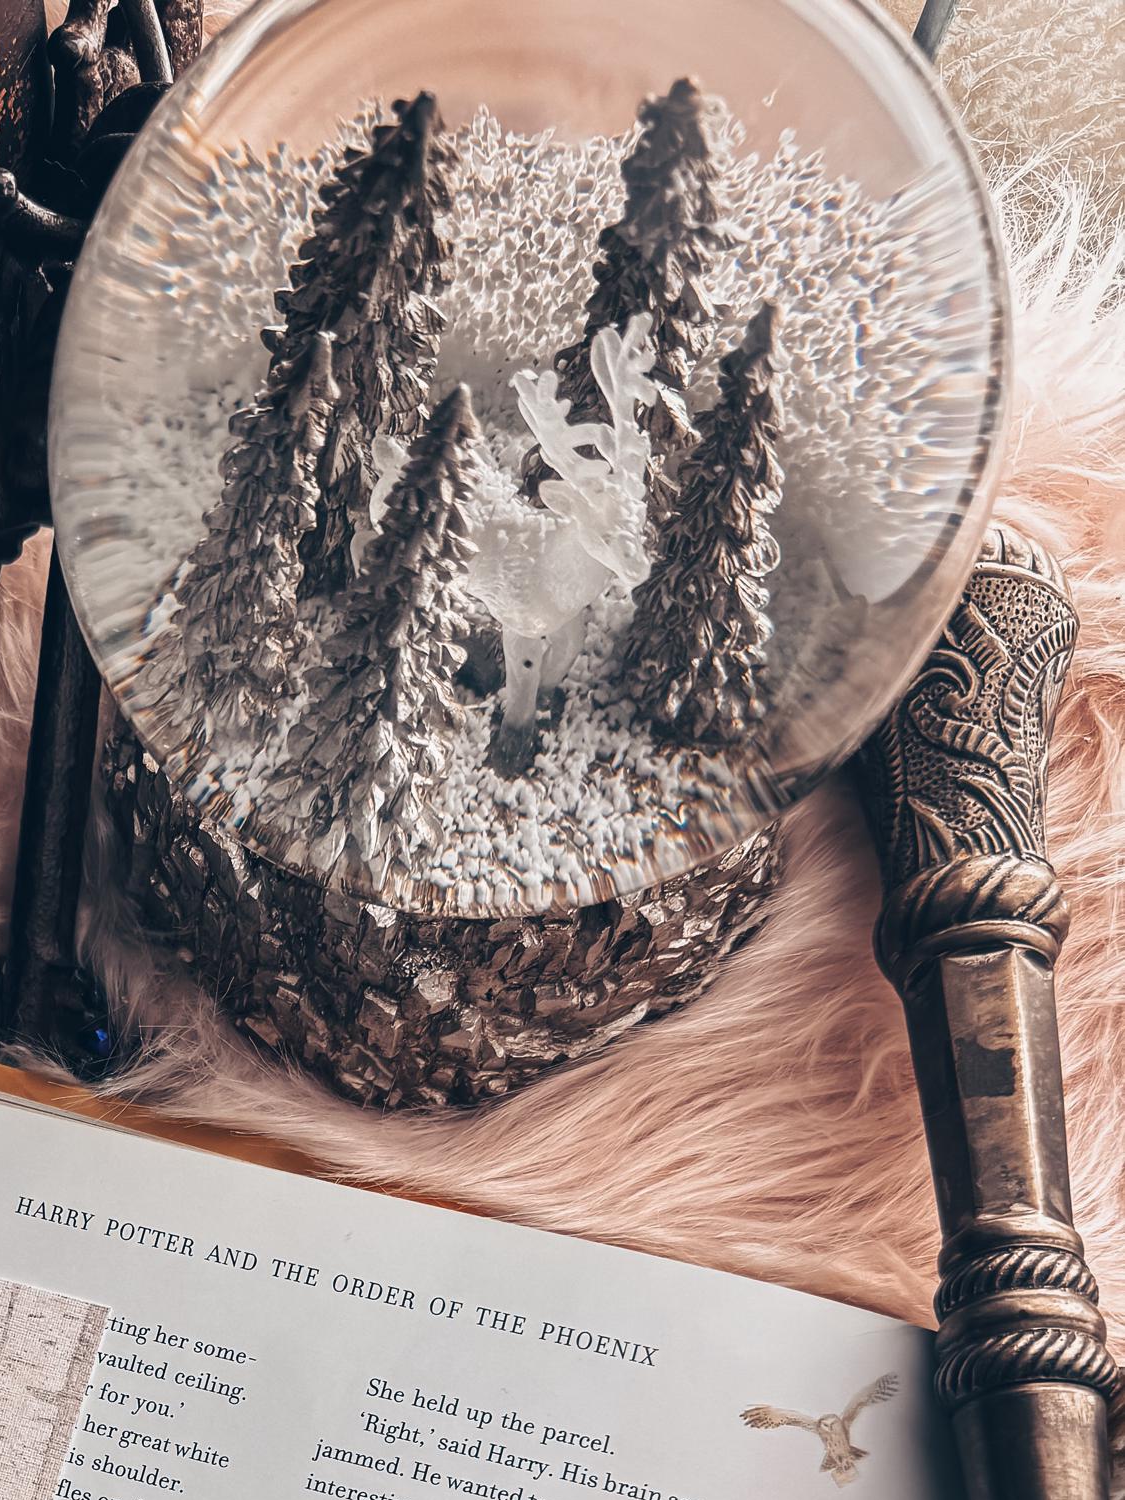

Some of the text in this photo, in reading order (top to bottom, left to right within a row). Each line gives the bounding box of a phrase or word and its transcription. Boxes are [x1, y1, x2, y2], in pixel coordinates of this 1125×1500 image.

[14, 1195, 660, 1368] HARRY POTTER AND THE ORDER OF THE PHOENIX
[96, 1350, 247, 1406] vaulted ceiling.
[81, 1412, 230, 1469] her great white
[365, 1377, 615, 1456] She held up the parcel.
[90, 1453, 182, 1492] shoulder.
[310, 1442, 405, 1478] jammed.
[410, 1460, 442, 1487] He
